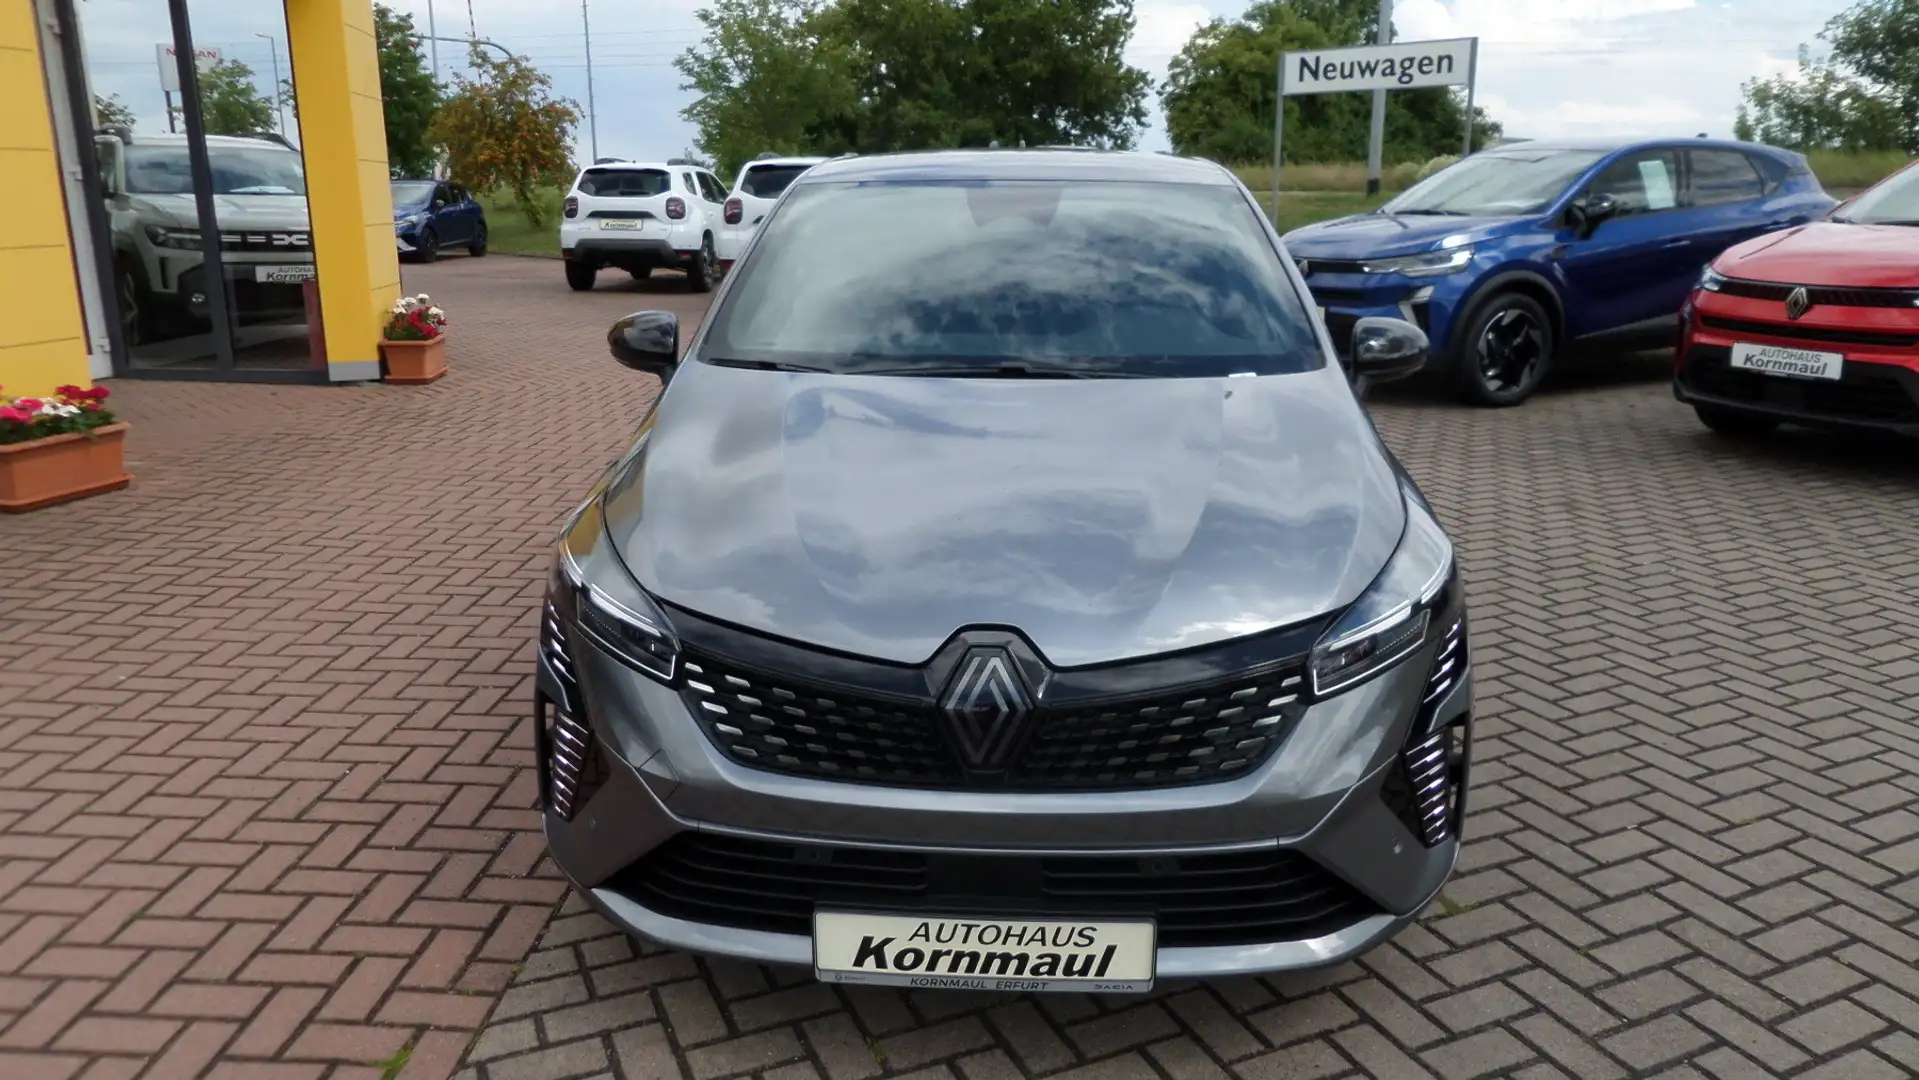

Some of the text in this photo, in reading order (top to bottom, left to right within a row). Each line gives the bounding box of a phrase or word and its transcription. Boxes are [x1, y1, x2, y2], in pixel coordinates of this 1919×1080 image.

[1298, 53, 1454, 85] Neuwagen
[1743, 353, 1829, 376] Kornmaul
[1760, 348, 1822, 363] AUTOHAUS
[908, 922, 1098, 948] AUTOHAUS
[852, 935, 1118, 978] Kornmaul
[910, 977, 1049, 991] KORNMAUL ERFURT
